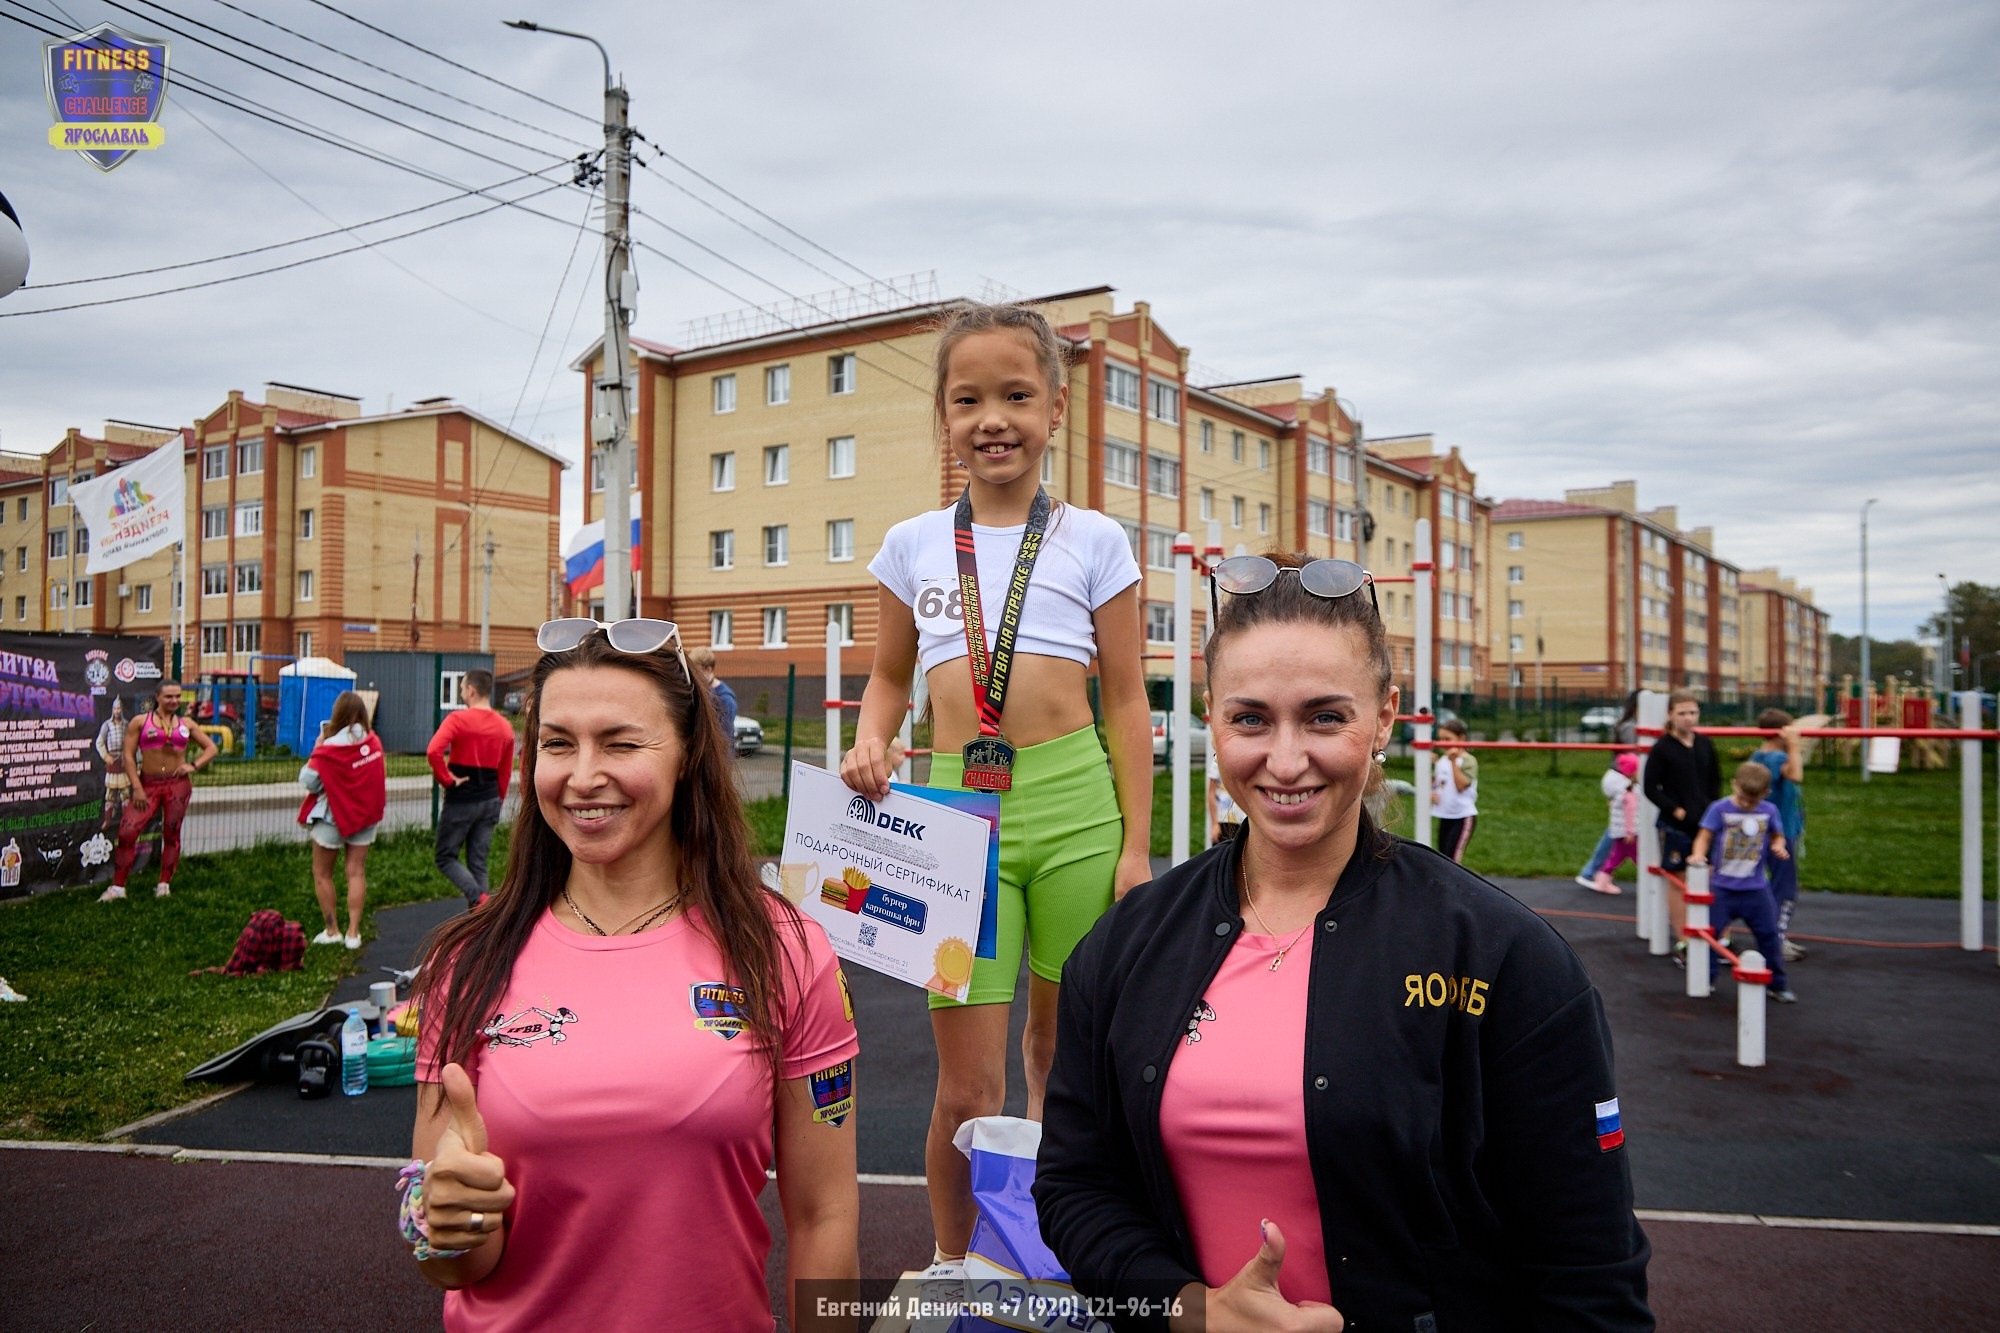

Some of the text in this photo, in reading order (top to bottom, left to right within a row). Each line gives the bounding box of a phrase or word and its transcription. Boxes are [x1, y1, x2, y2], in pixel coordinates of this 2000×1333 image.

[1022, 541, 1038, 551] 08
[1026, 532, 1042, 542] 17
[1019, 550, 1036, 560] 24
[961, 573, 982, 686] КУБОК ЯРОСЛАВСКОЙ ОБЛАСТИ
[967, 575, 989, 688] ПО ФИТНЕС-ЧЕЛЛЕНДЖУ
[989, 565, 1030, 702] БИТВА НА СТРЕЛКЕ
[0, 650, 59, 684] ИТВА
[970, 763, 1008, 773] FITNESS
[965, 773, 1011, 789] CHALLENGE
[795, 832, 883, 874] ПОДАРОЧНЫЙ
[886, 864, 971, 903] СЕРТИФИКАТ
[882, 893, 908, 911] бургер
[865, 902, 921, 928] картошка фри
[700, 987, 745, 1004] FITNESS
[815, 1062, 848, 1083] FITNESS
